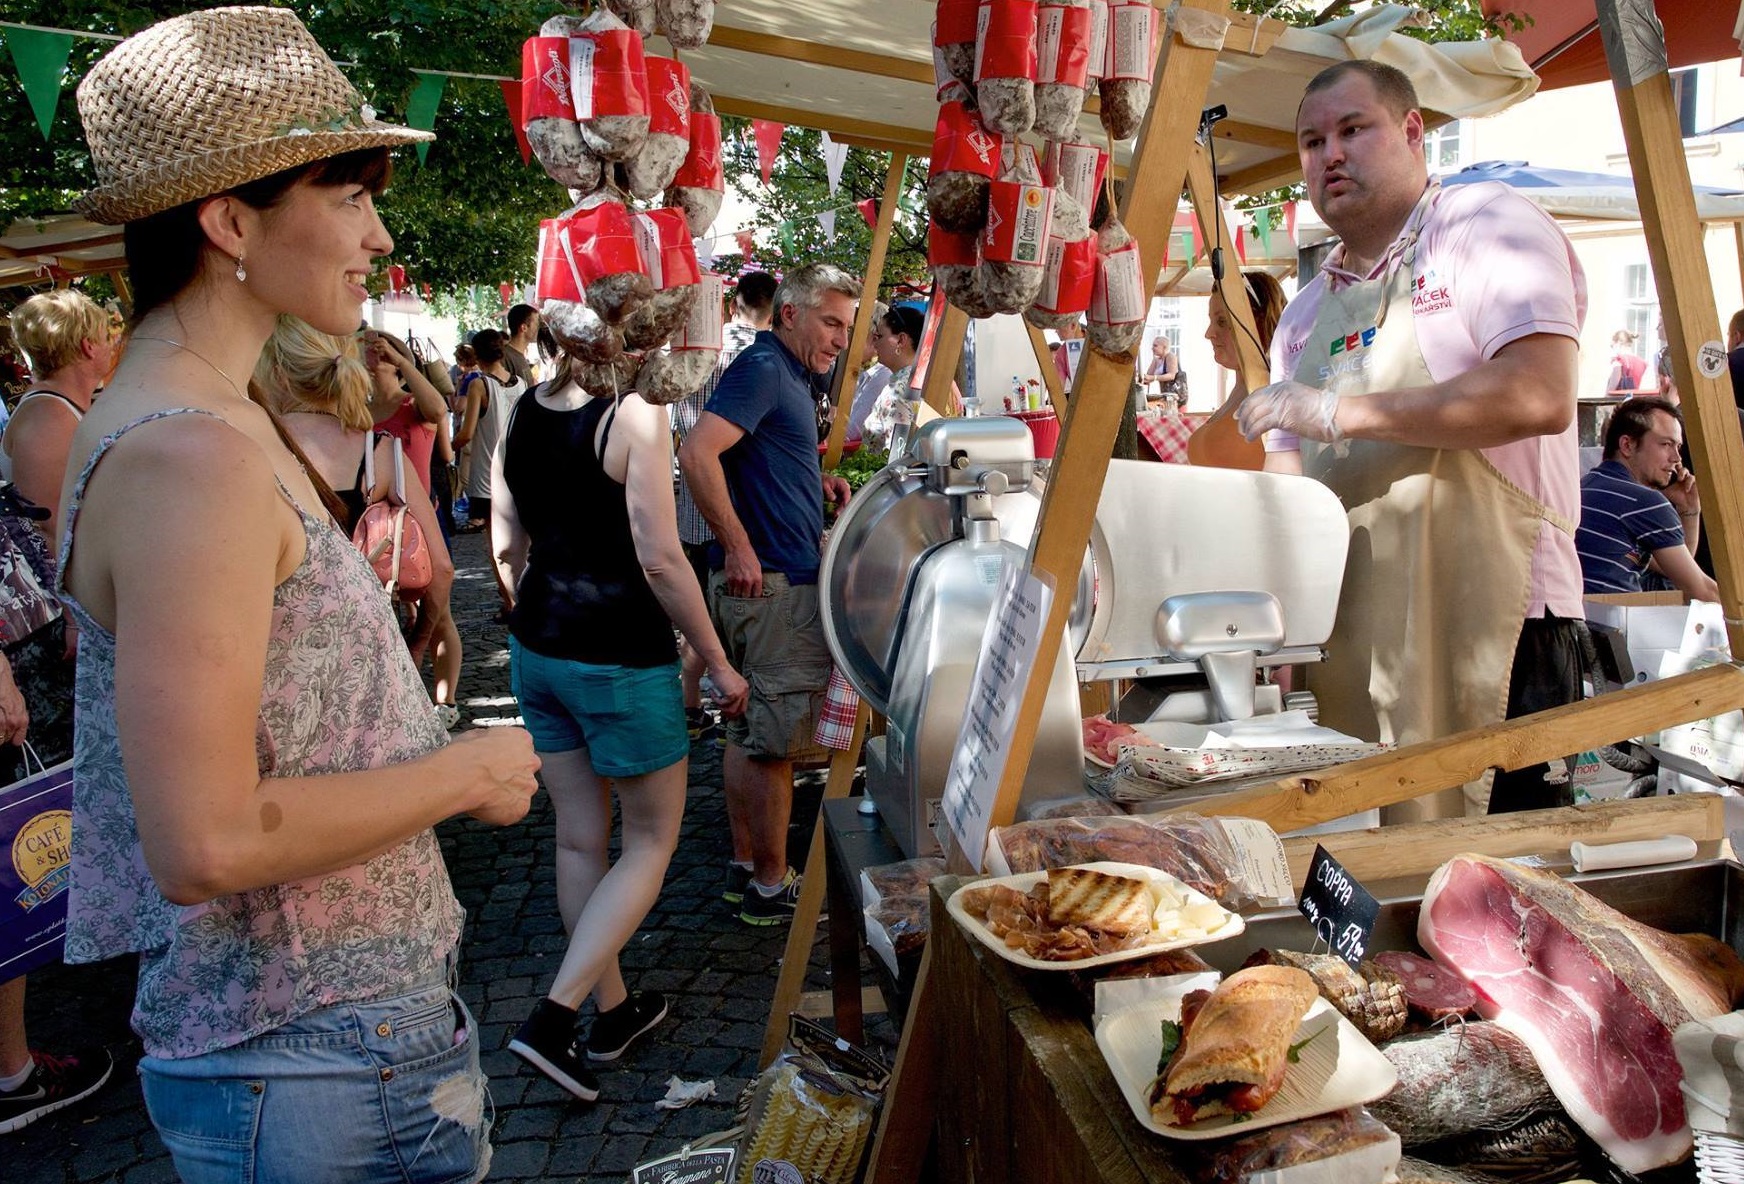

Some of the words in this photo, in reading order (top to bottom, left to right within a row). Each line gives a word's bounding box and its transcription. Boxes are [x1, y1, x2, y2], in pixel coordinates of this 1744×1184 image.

[26, 822, 66, 853] CAFÉ
[36, 856, 45, 866] &
[1316, 859, 1354, 907] COPPA
[704, 1155, 725, 1165] PASTA
